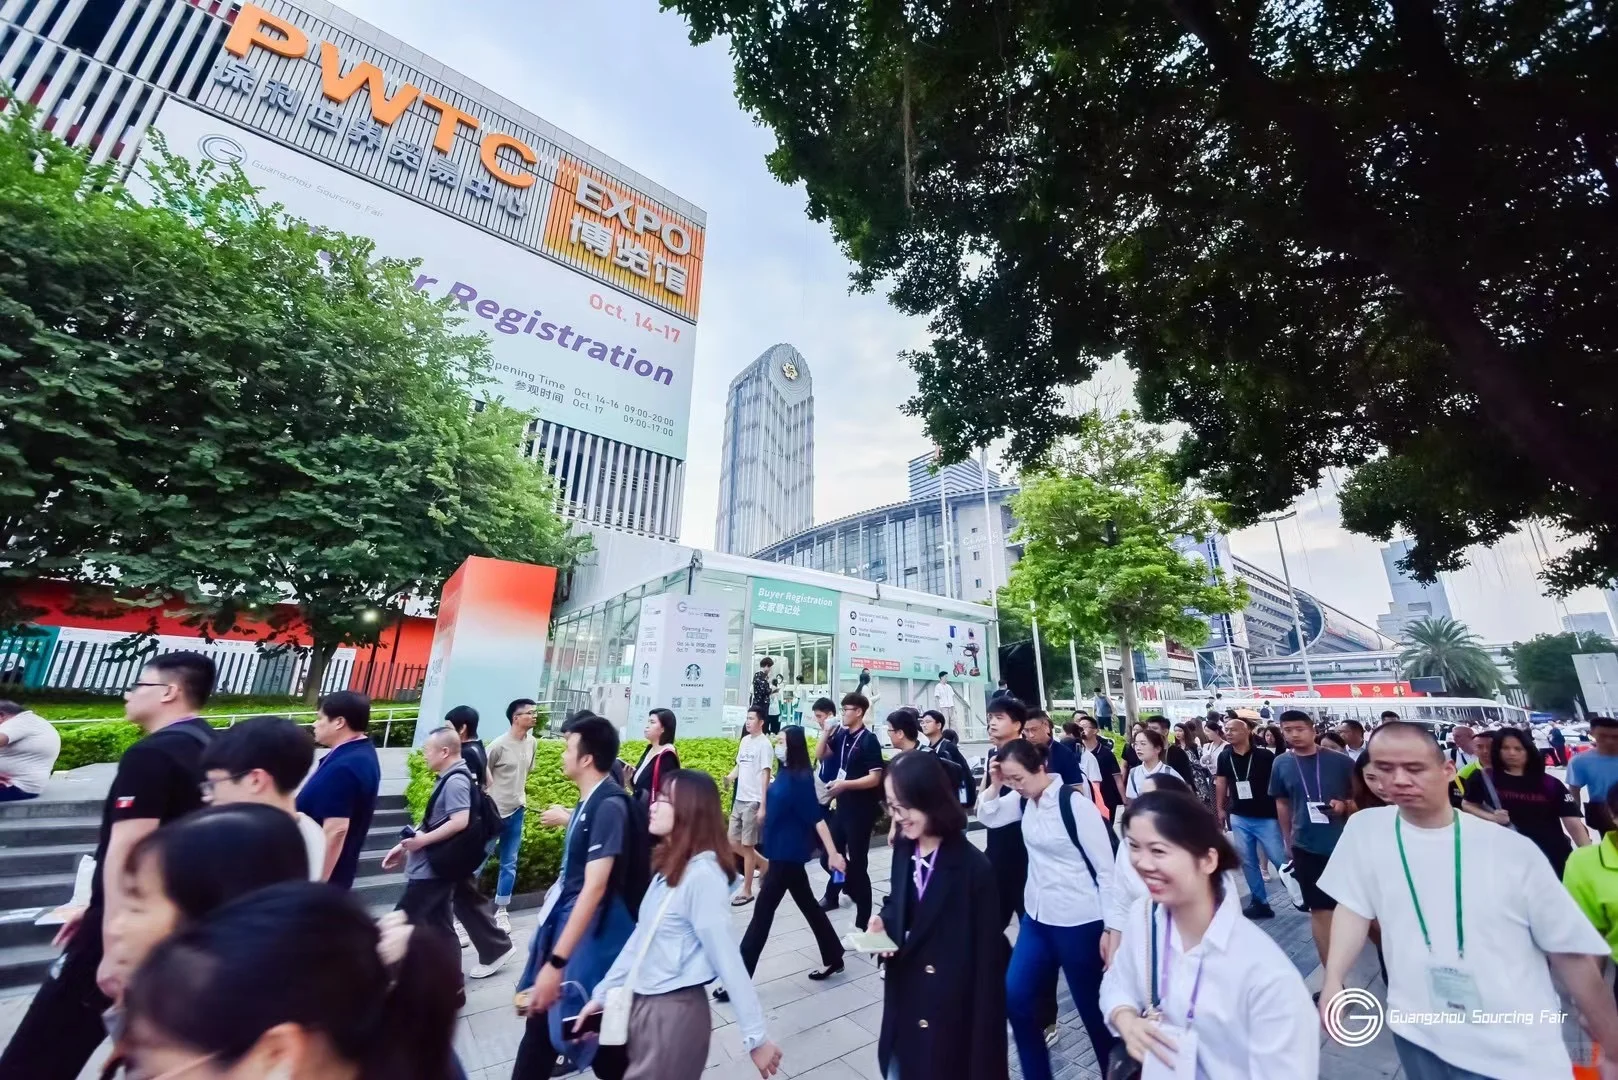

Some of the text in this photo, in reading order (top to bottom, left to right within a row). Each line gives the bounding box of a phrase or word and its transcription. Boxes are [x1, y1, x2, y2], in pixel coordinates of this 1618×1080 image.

[224, 2, 537, 189] PWTC
[211, 58, 528, 219] 保利世界贸易中心
[251, 159, 384, 218] Guangzhou Sourcing Fair
[575, 174, 691, 256] EXPO
[570, 211, 688, 296] 博览馆
[449, 281, 674, 386] Registration
[589, 293, 681, 343] Oct. 14-17
[514, 380, 564, 404] 参观时间
[538, 374, 566, 391] Time
[574, 387, 674, 427] Oct. 14-16 09:00-20:00
[572, 399, 674, 437] Oct. 17 09:00-17:00
[758, 587, 833, 607] Buyer Registration
[758, 601, 800, 616] 买家登记处
